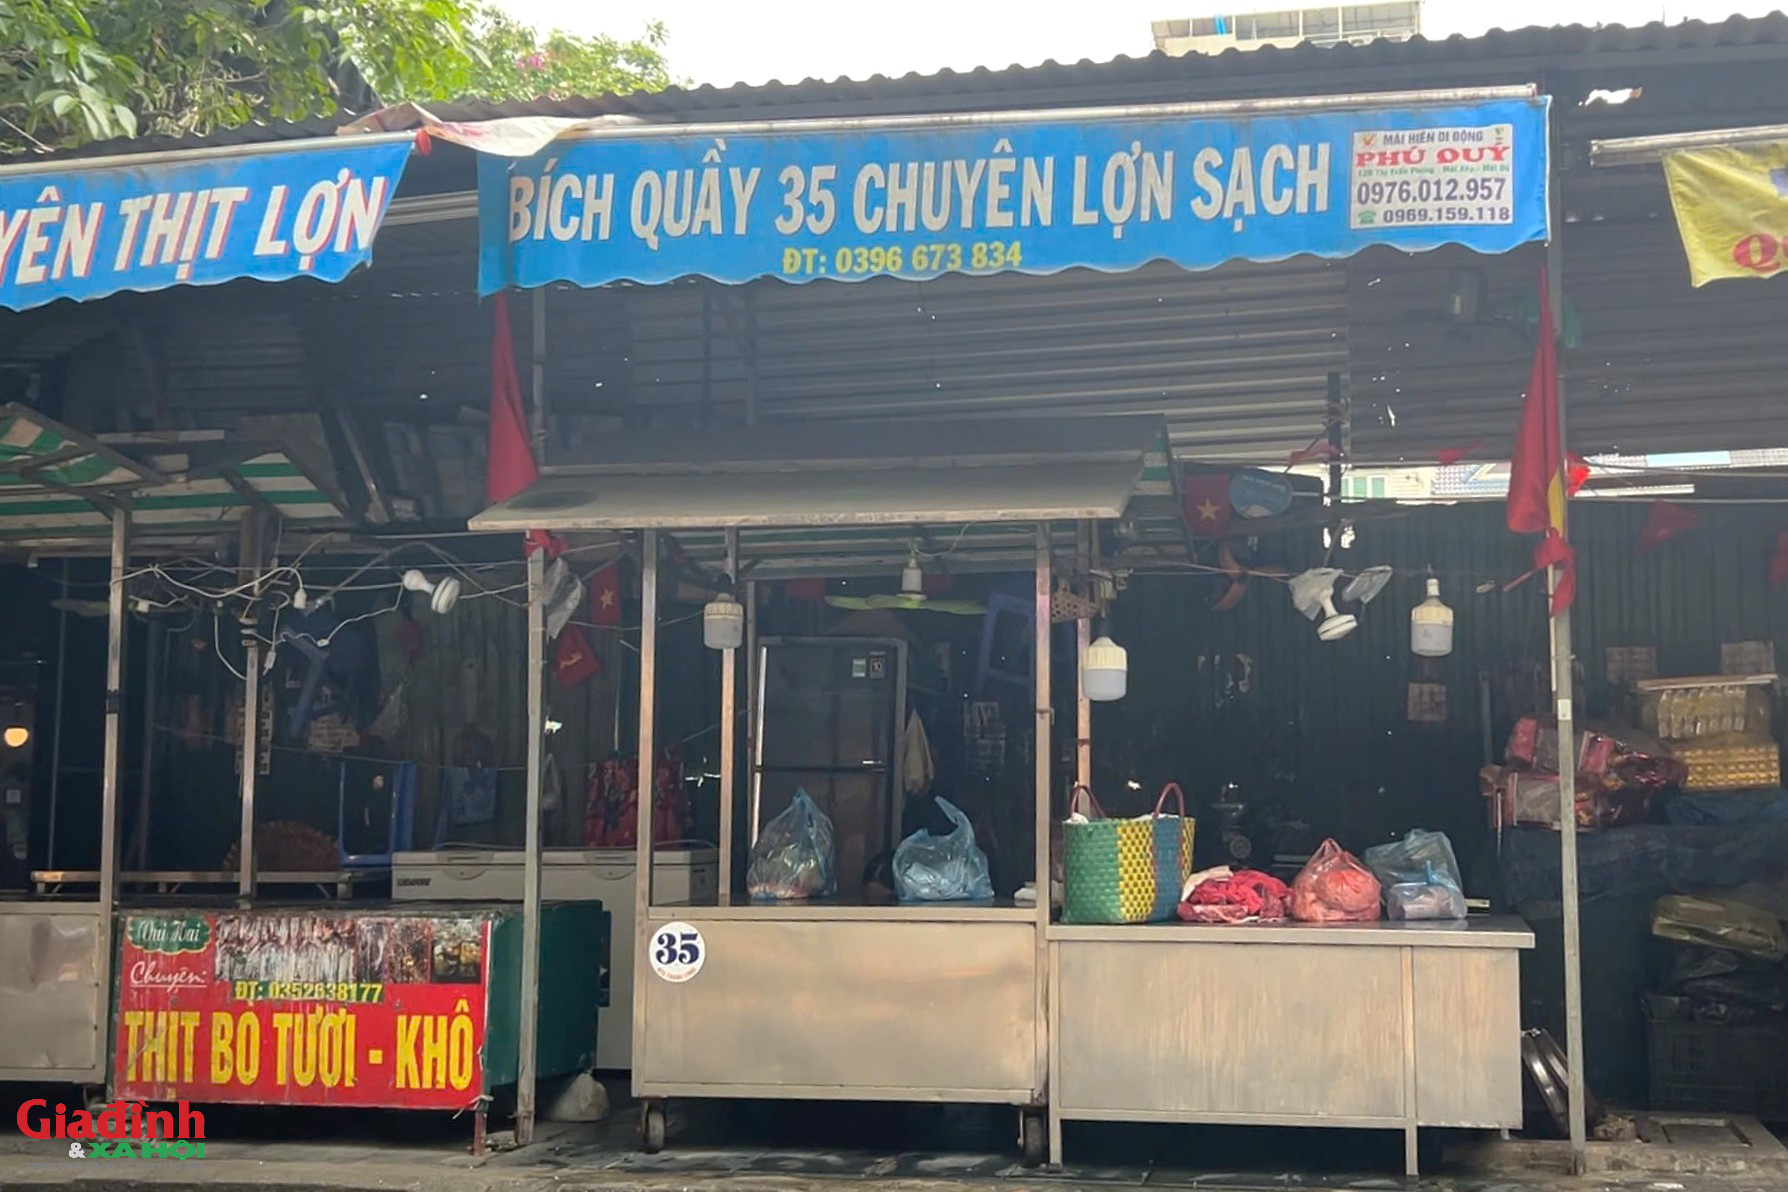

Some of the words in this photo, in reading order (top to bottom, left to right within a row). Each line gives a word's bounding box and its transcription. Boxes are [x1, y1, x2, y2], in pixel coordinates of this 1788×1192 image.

[1438, 131, 1449, 142] DI
[509, 158, 615, 243] BÍCH
[630, 138, 761, 251] QUẦY
[775, 165, 837, 236] 35
[853, 138, 1055, 234] CHUYÊN
[1072, 140, 1174, 240] LỢN
[1190, 142, 1331, 233] SẠCH
[1357, 177, 1506, 204] 0976.012.957
[113, 186, 250, 282] THỊT
[253, 167, 387, 272] LỢN
[1383, 206, 1510, 224] 0969.159.118
[783, 247, 827, 275] ĐT:
[835, 246, 903, 273] 0396
[912, 243, 963, 271] 673
[971, 240, 1023, 269] 834
[655, 931, 699, 965] 35
[272, 1003, 357, 1089] TƯƠI
[369, 1049, 383, 1064] -
[395, 999, 475, 1091] KHÔ
